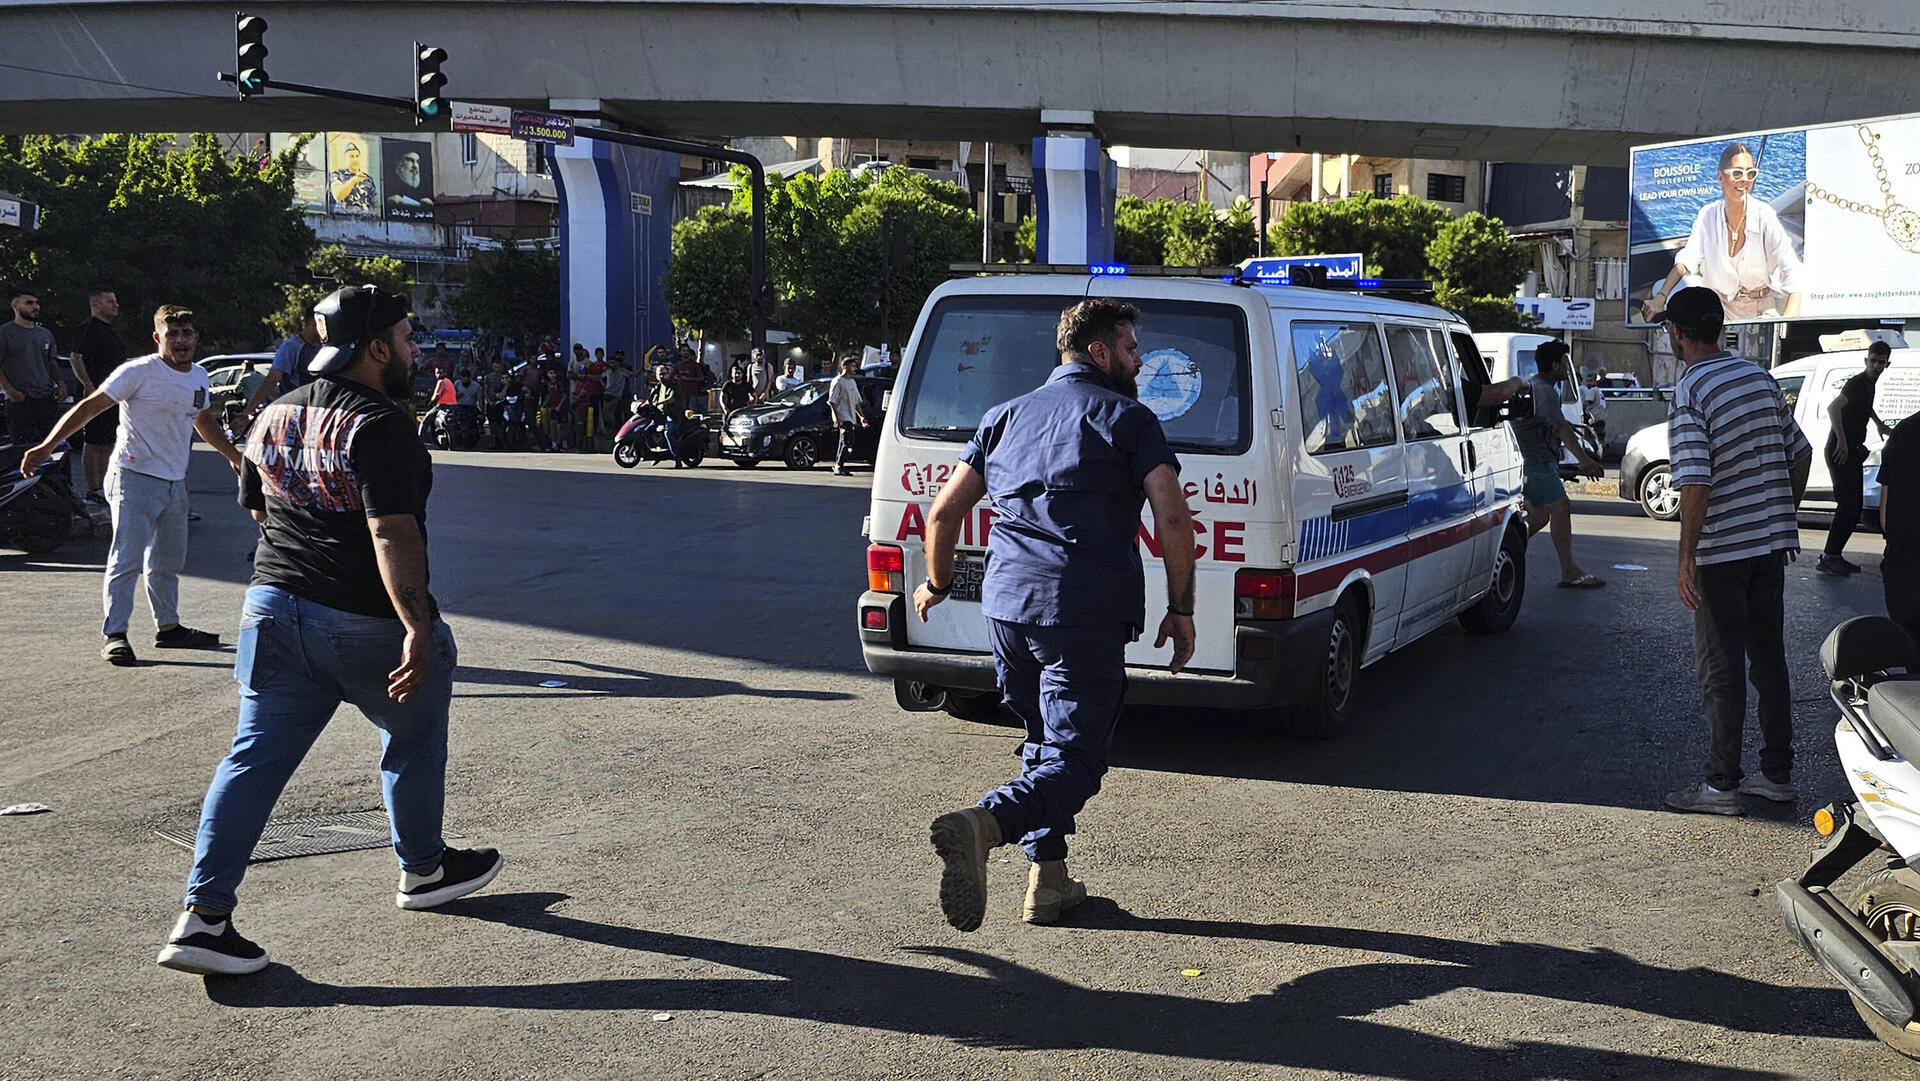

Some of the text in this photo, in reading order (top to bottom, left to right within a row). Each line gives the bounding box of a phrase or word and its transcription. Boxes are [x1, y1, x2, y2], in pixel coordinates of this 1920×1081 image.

[529, 126, 567, 140] 3.500.000
[1653, 163, 1701, 178] BOUSSOLE
[1656, 175, 1697, 186] COLLECTION
[1639, 185, 1714, 201] LEAD YOUR OWN WAY
[0, 204, 18, 218] شر
[922, 463, 957, 483] 12
[1340, 464, 1355, 484] 125
